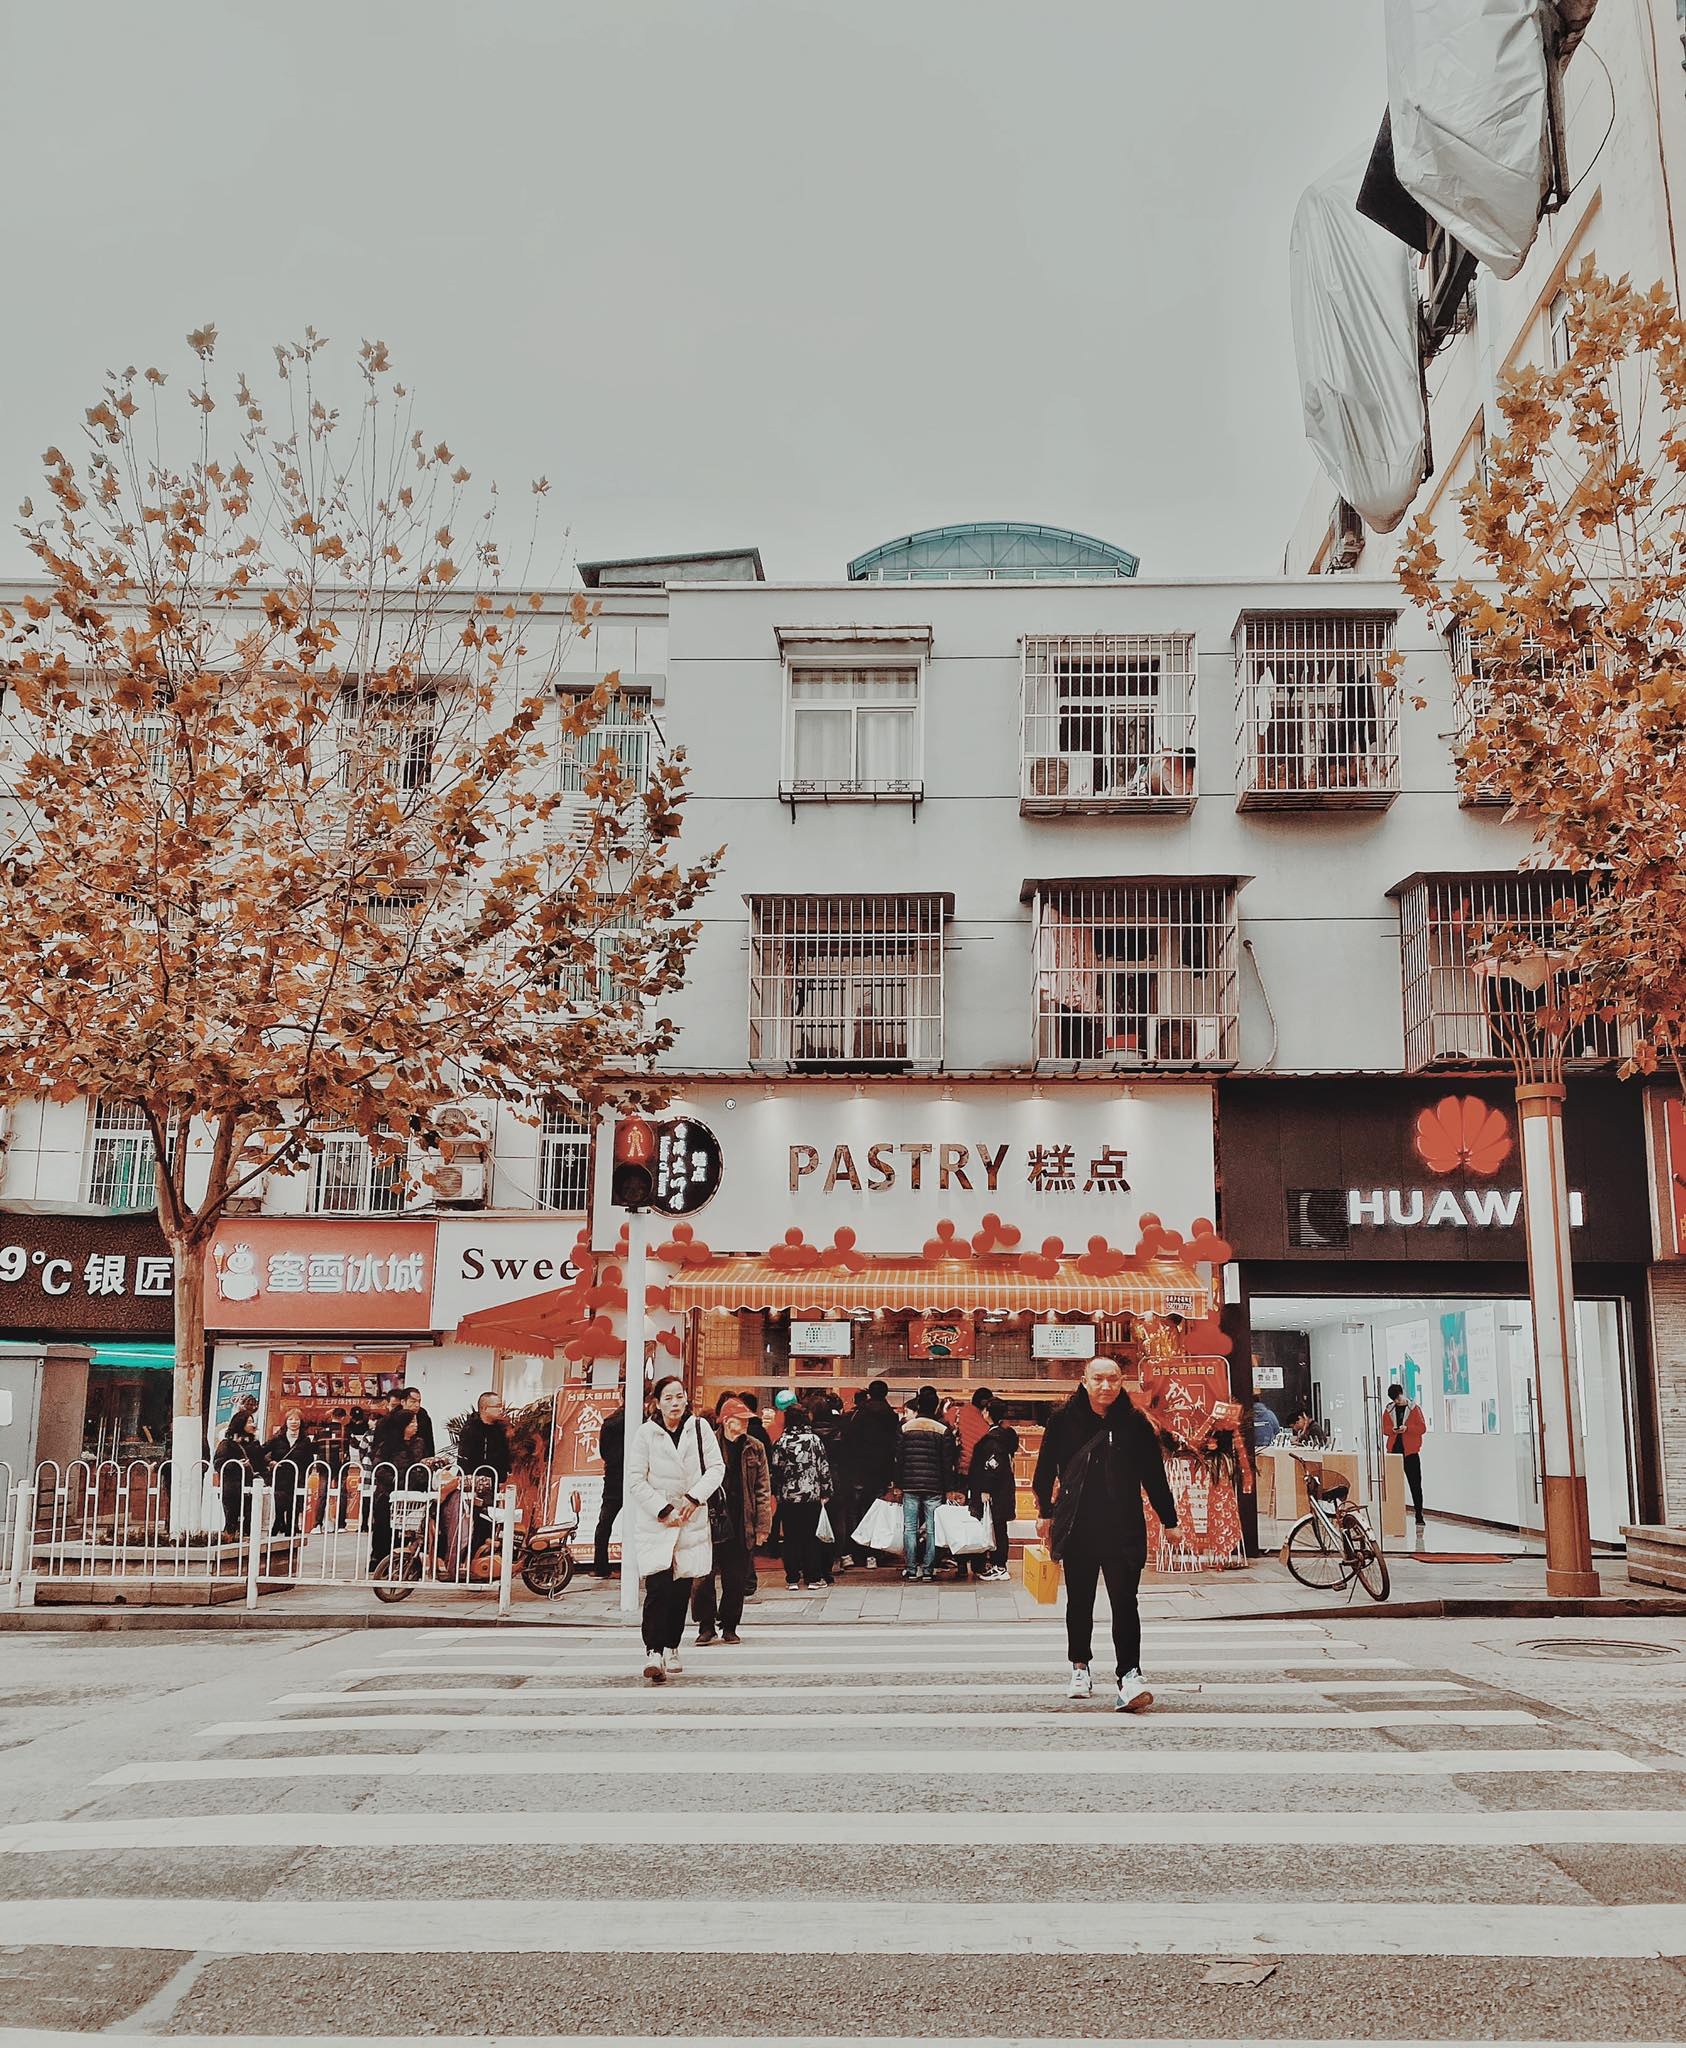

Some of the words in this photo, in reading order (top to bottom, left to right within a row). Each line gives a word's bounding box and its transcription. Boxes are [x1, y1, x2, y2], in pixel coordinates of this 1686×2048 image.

[789, 1143, 1011, 1191] PASTRY
[1027, 1144, 1133, 1192] 糕点
[1349, 1190, 1583, 1226] HUAWI
[84, 1253, 174, 1296] 银匠
[267, 1252, 425, 1293] 蜜雪冰城
